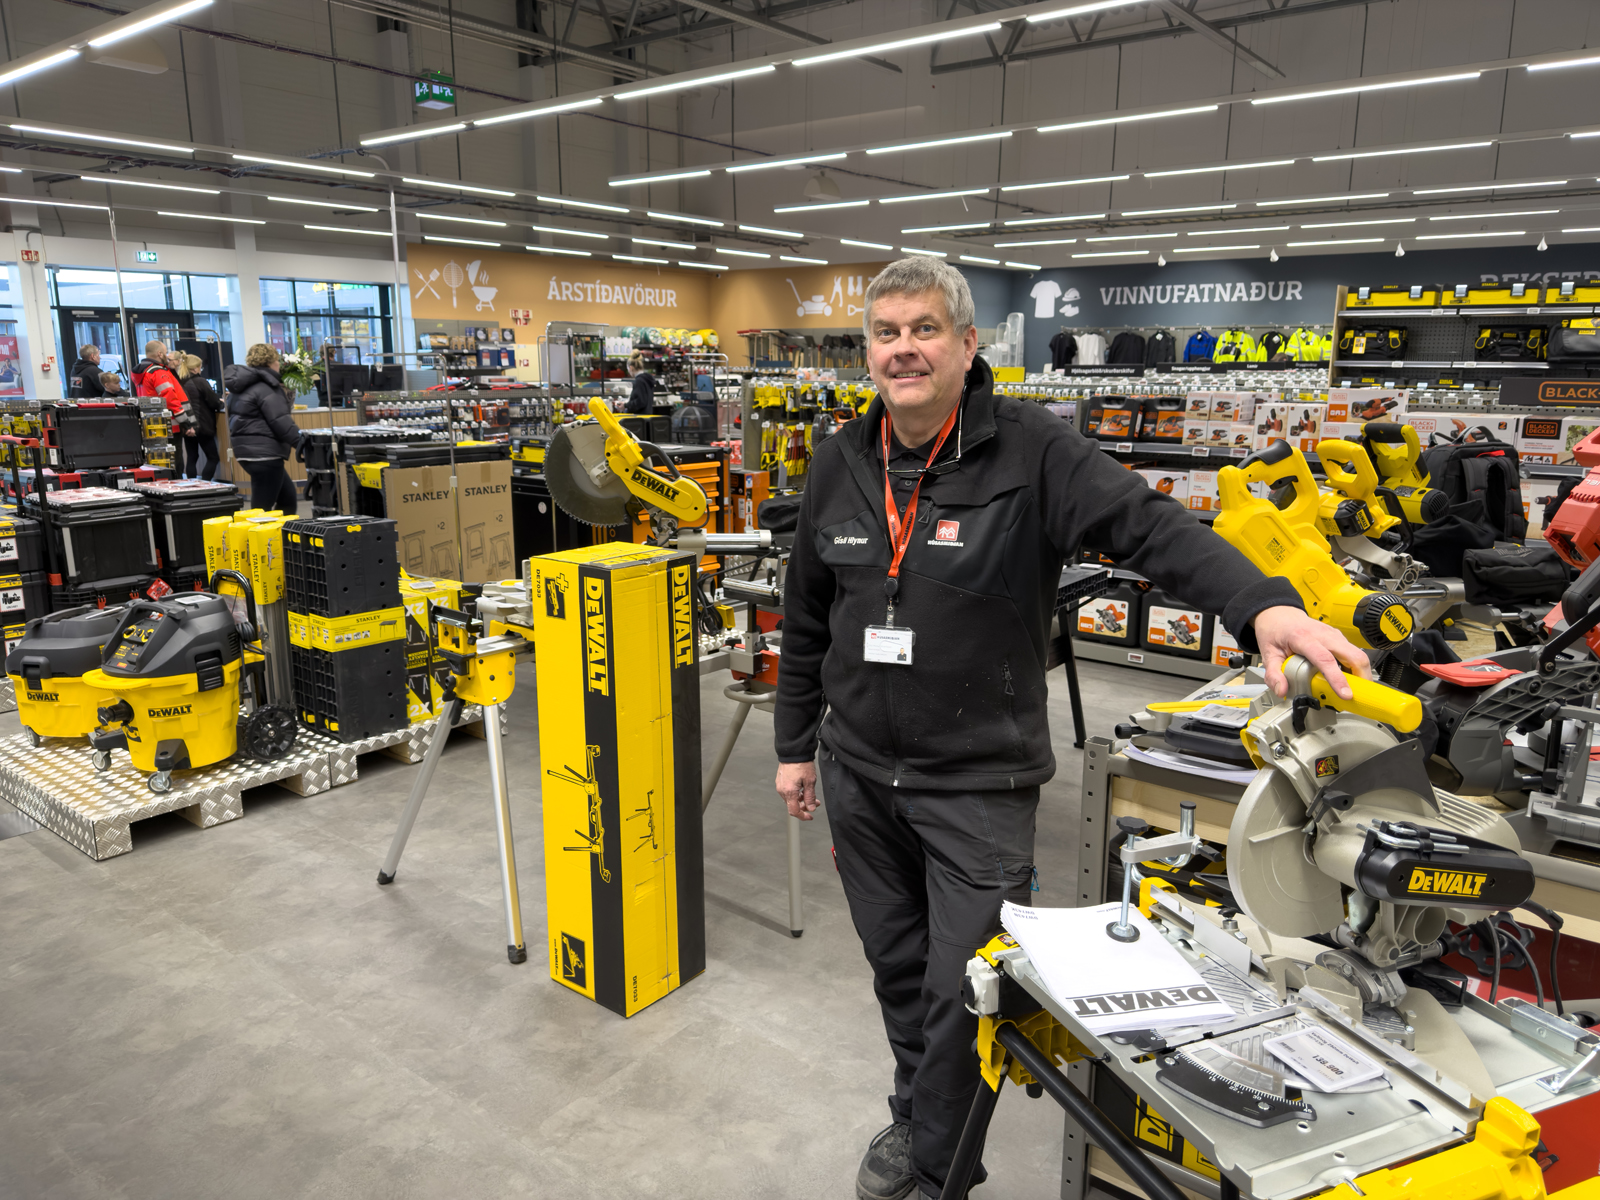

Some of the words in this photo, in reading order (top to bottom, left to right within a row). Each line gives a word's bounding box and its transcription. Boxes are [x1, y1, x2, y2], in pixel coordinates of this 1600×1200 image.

[547, 276, 678, 308] ÁRSTÍÐAVÖRUR
[1100, 281, 1303, 306] VINNUFATNAÐUR
[402, 490, 450, 503] STANLEY
[464, 484, 508, 497] STANLEY
[252, 554, 260, 583] STANLEY
[355, 615, 381, 624] STANLEY
[409, 701, 430, 717] 2X
[1074, 986, 1220, 1016] DEWALT
[1312, 1054, 1345, 1076] 139.900
